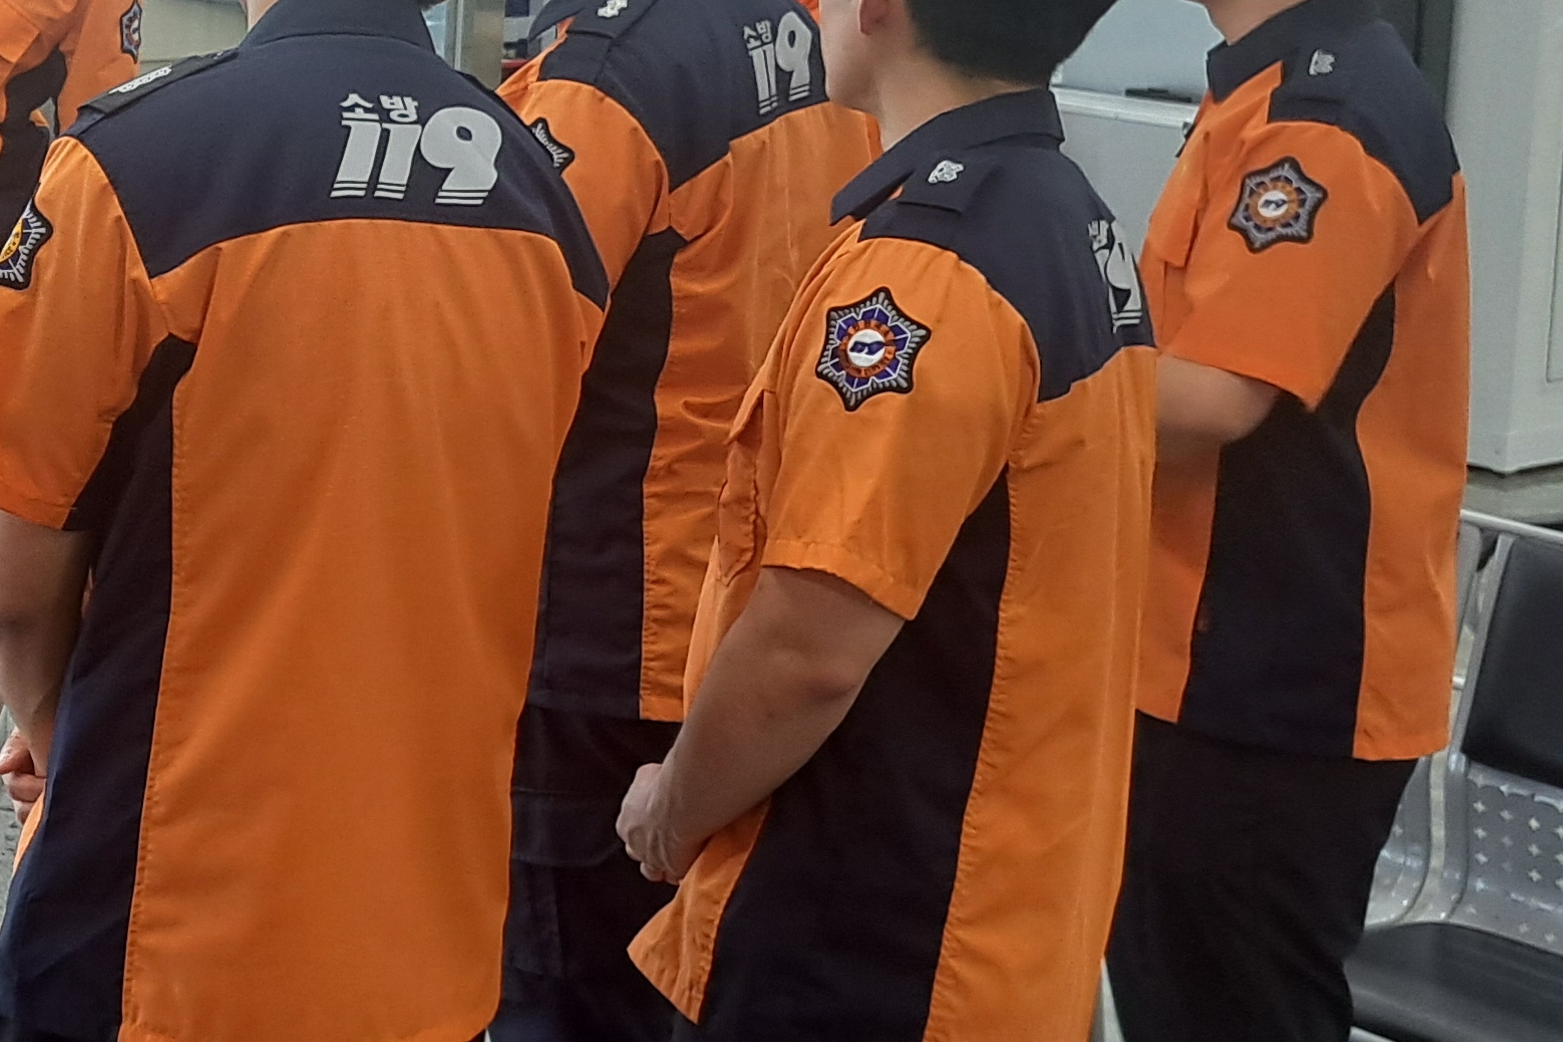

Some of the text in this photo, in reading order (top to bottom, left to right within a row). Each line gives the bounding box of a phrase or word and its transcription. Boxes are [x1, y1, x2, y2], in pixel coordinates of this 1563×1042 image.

[743, 20, 772, 49] 소방
[749, 11, 813, 115] 119
[340, 93, 419, 123] 소방
[330, 106, 502, 205] 119
